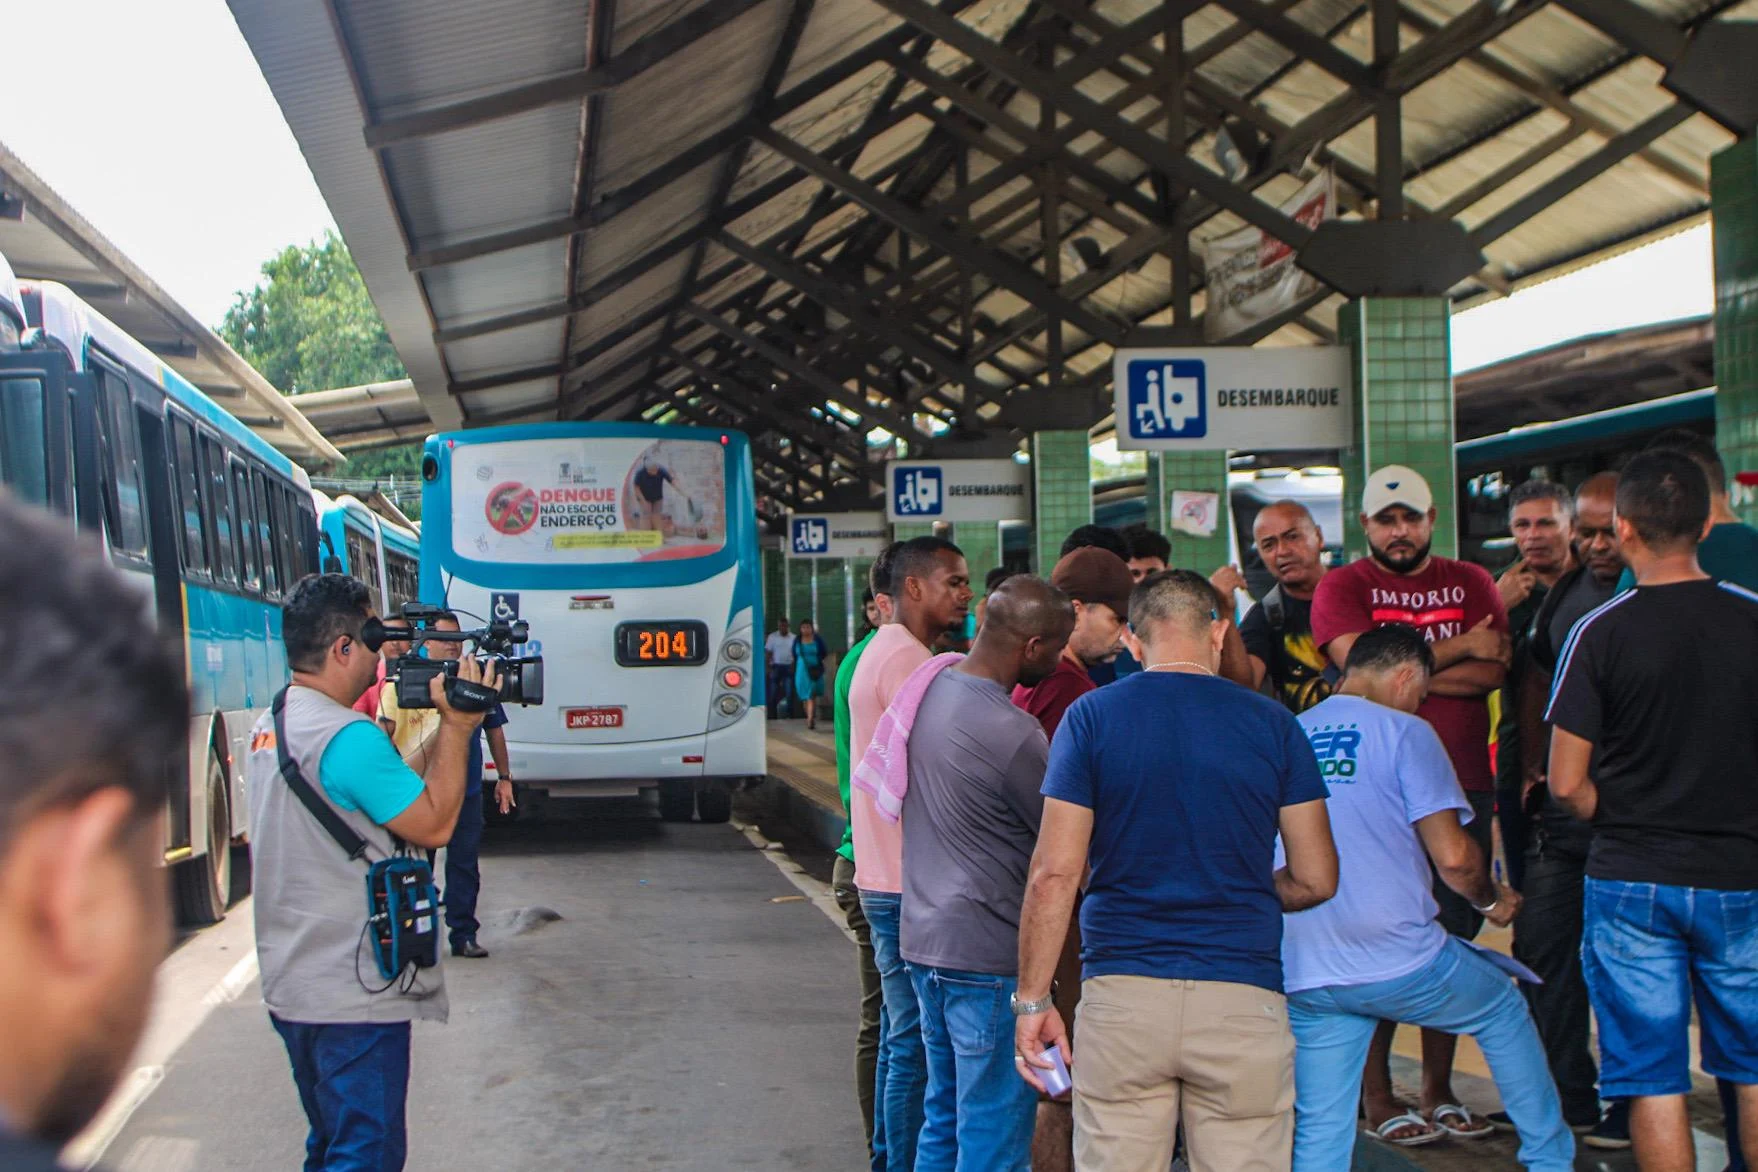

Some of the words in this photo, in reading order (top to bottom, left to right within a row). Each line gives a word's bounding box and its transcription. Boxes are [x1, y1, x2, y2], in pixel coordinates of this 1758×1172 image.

[1217, 388, 1340, 408] DESEMBARQUE
[540, 488, 616, 502] DENGUE
[948, 484, 1024, 497] DESEMBARQUE
[540, 503, 566, 515] NÃO
[567, 503, 616, 514] ESCOLHE
[540, 514, 617, 530] ENDEREÇO
[639, 631, 688, 659] 204
[463, 690, 486, 701] SONY
